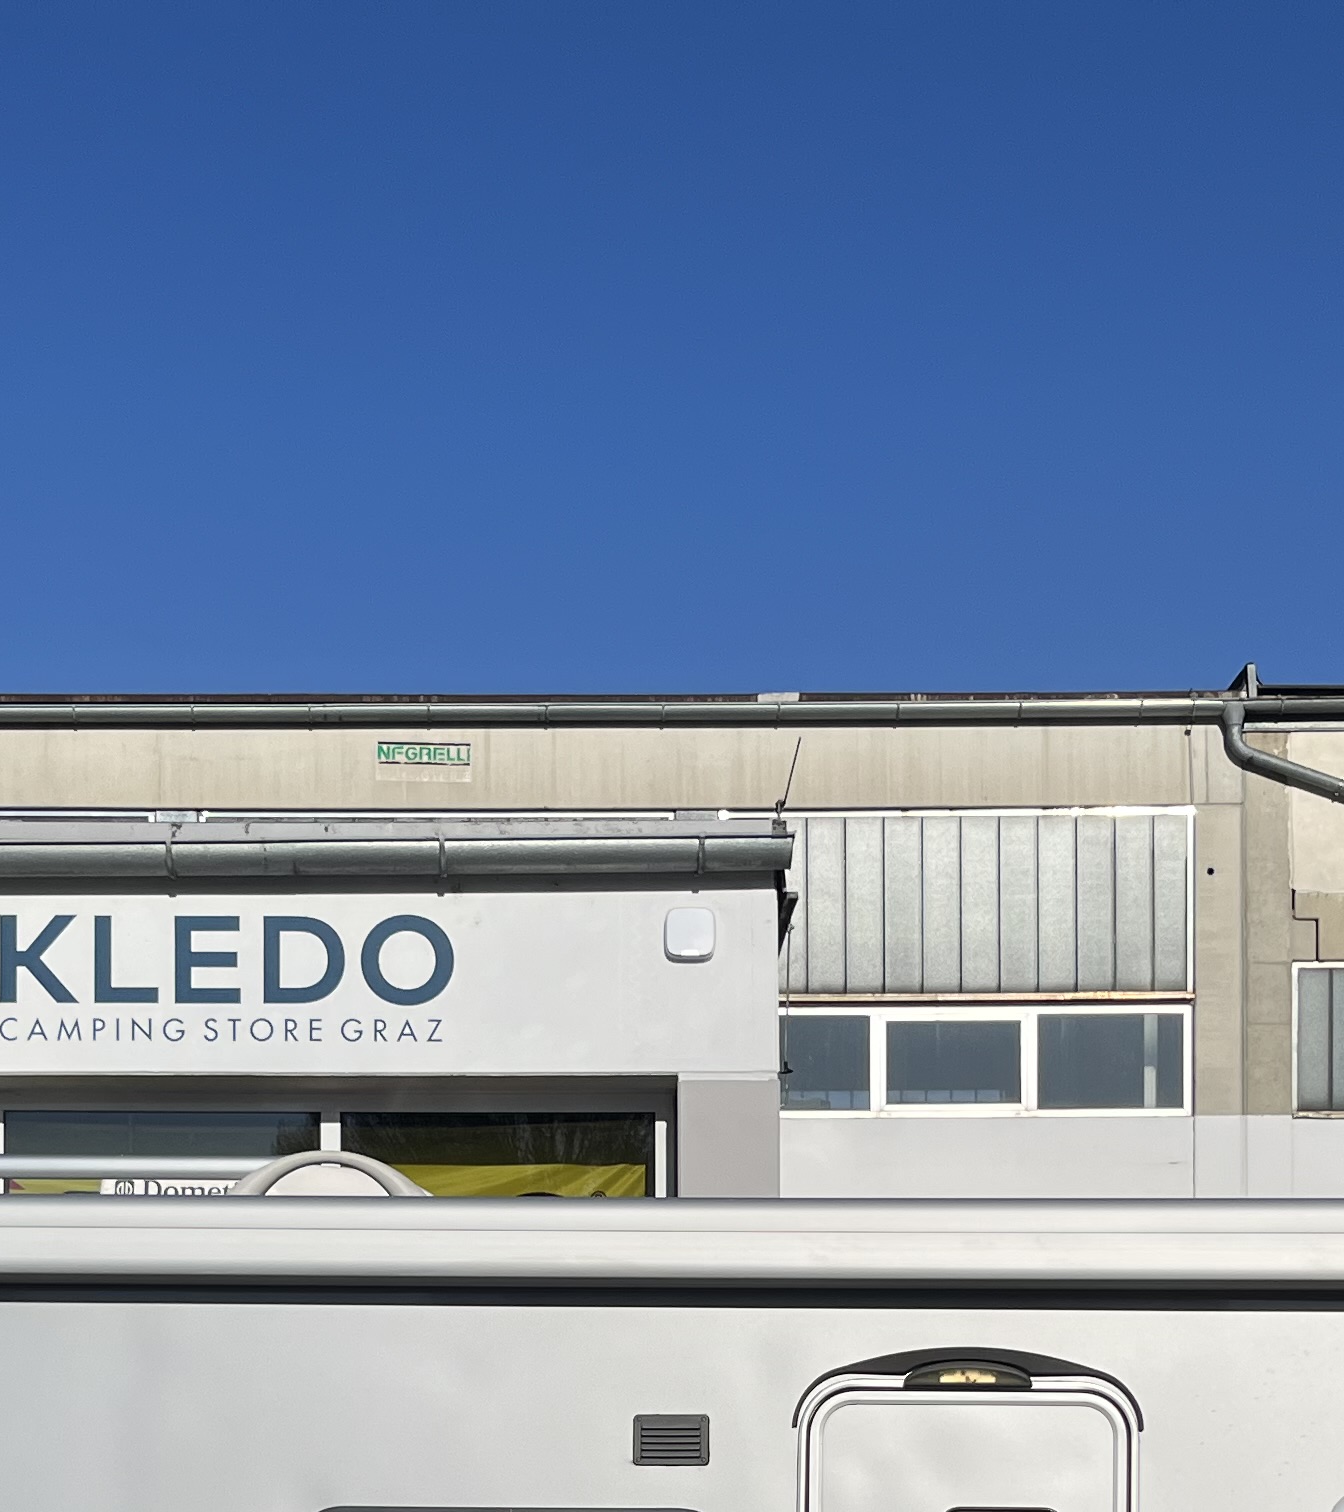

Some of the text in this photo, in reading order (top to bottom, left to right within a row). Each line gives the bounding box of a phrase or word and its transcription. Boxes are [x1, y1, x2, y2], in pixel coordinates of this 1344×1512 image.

[0, 914, 455, 1007] KLEDO
[0, 1017, 444, 1043] CAMPING STORE GRAZ
